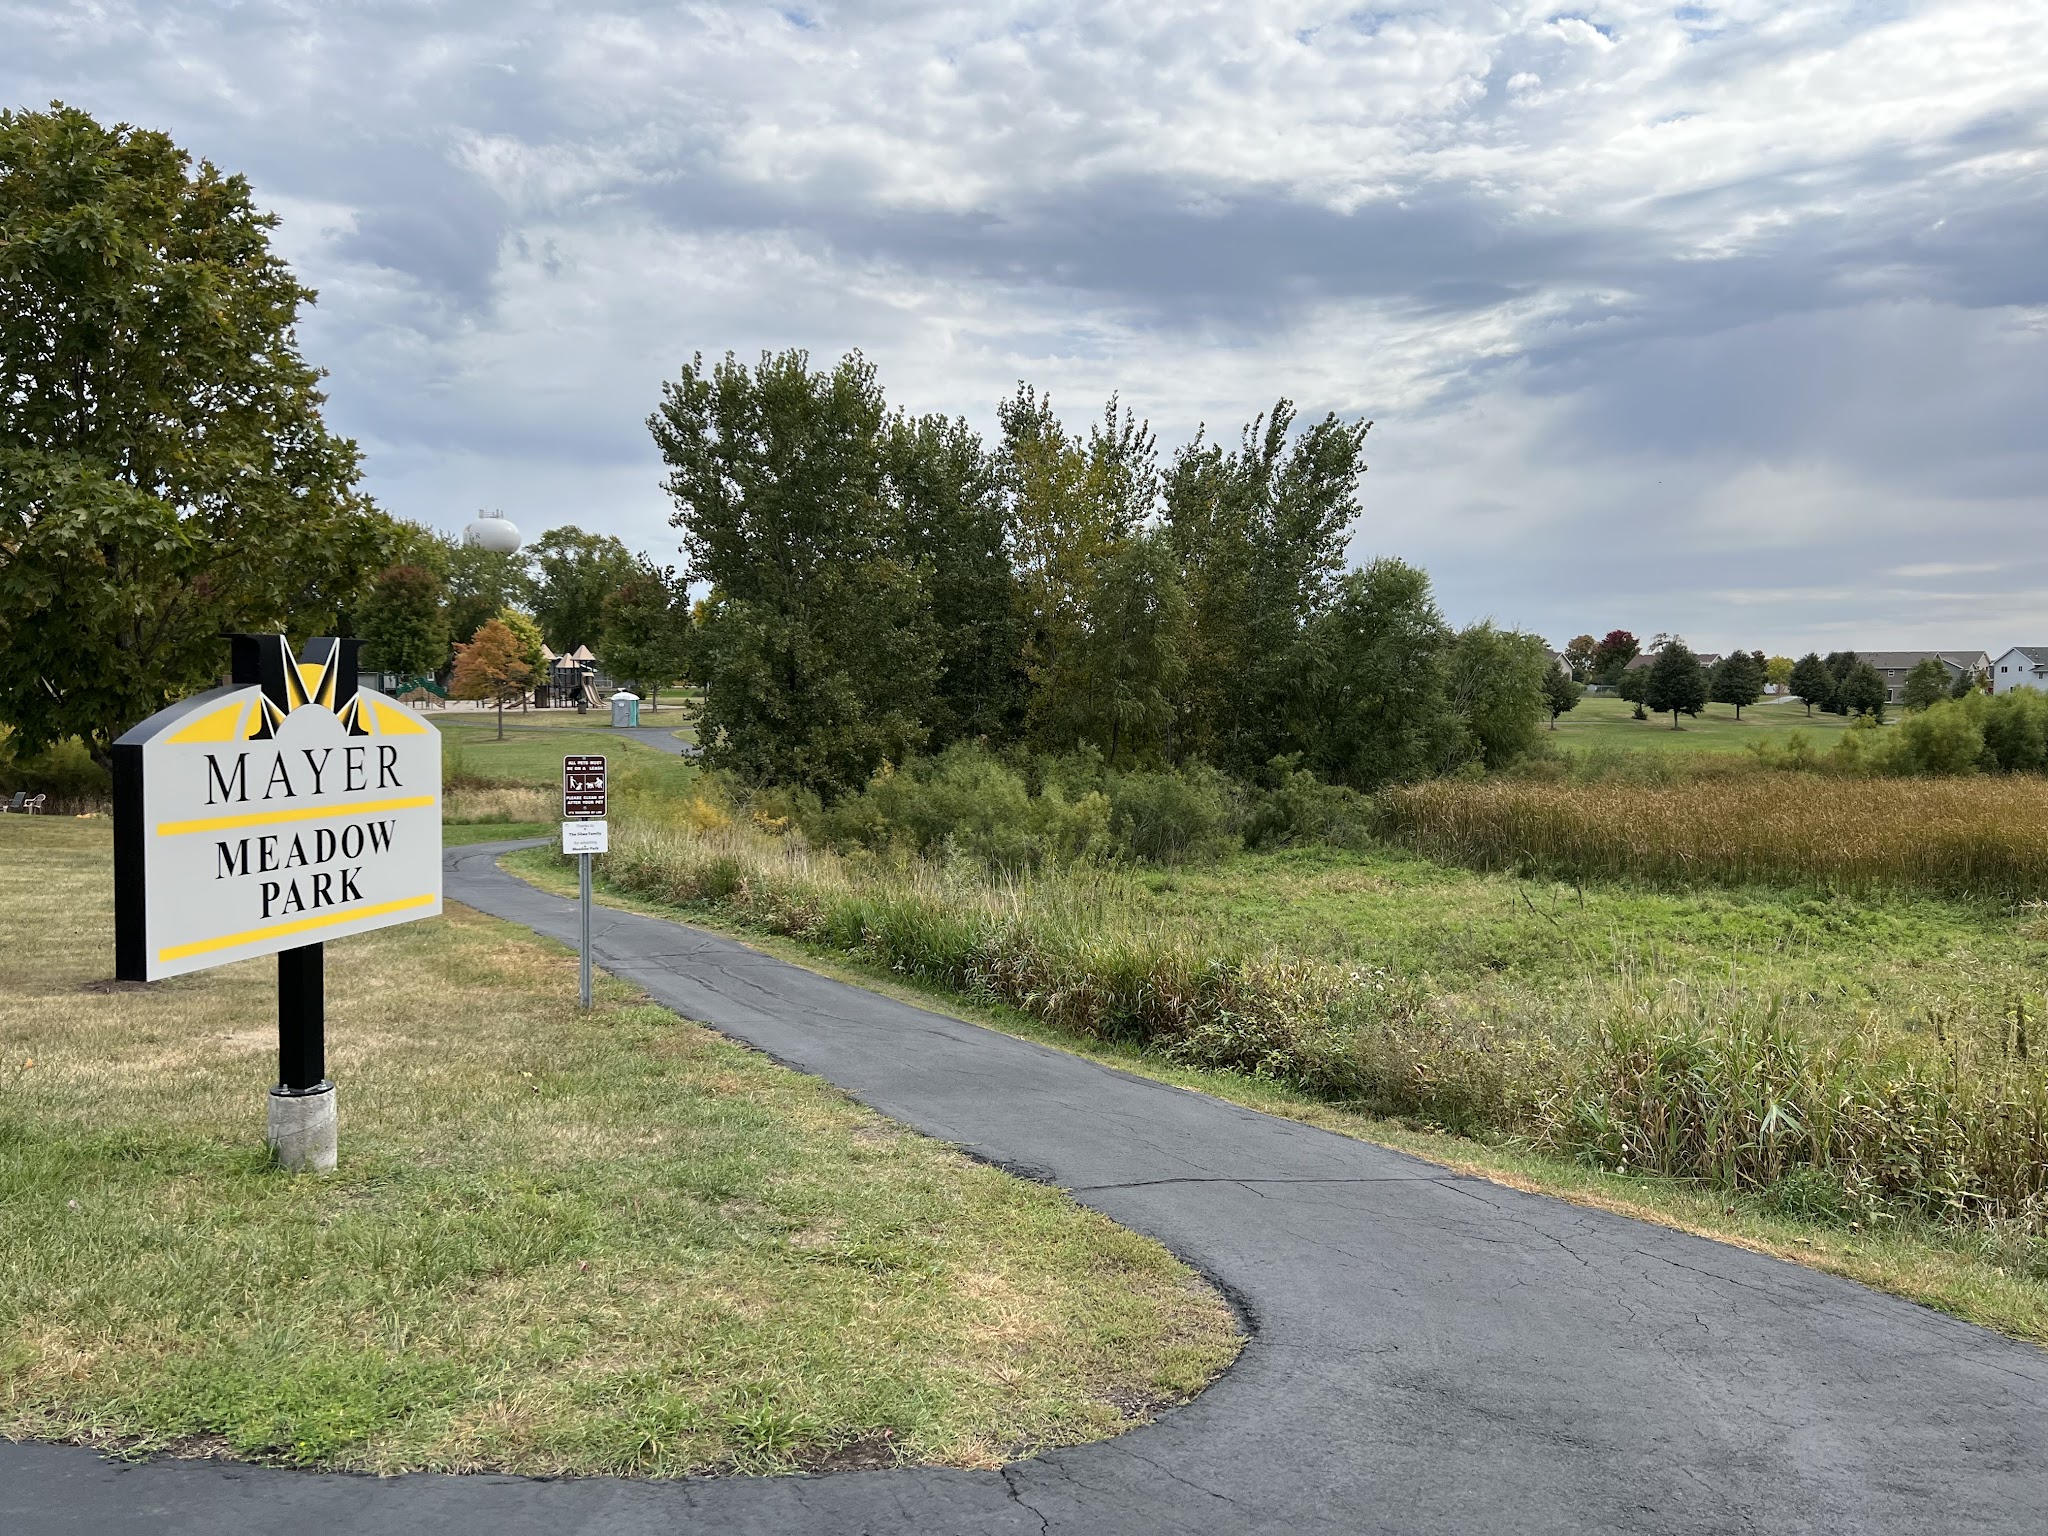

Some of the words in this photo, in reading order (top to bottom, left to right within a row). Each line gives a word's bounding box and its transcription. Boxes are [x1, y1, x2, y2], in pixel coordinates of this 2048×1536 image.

[203, 744, 403, 806] MAYER
[215, 819, 397, 880] MEADOW
[259, 866, 365, 920] PARK
